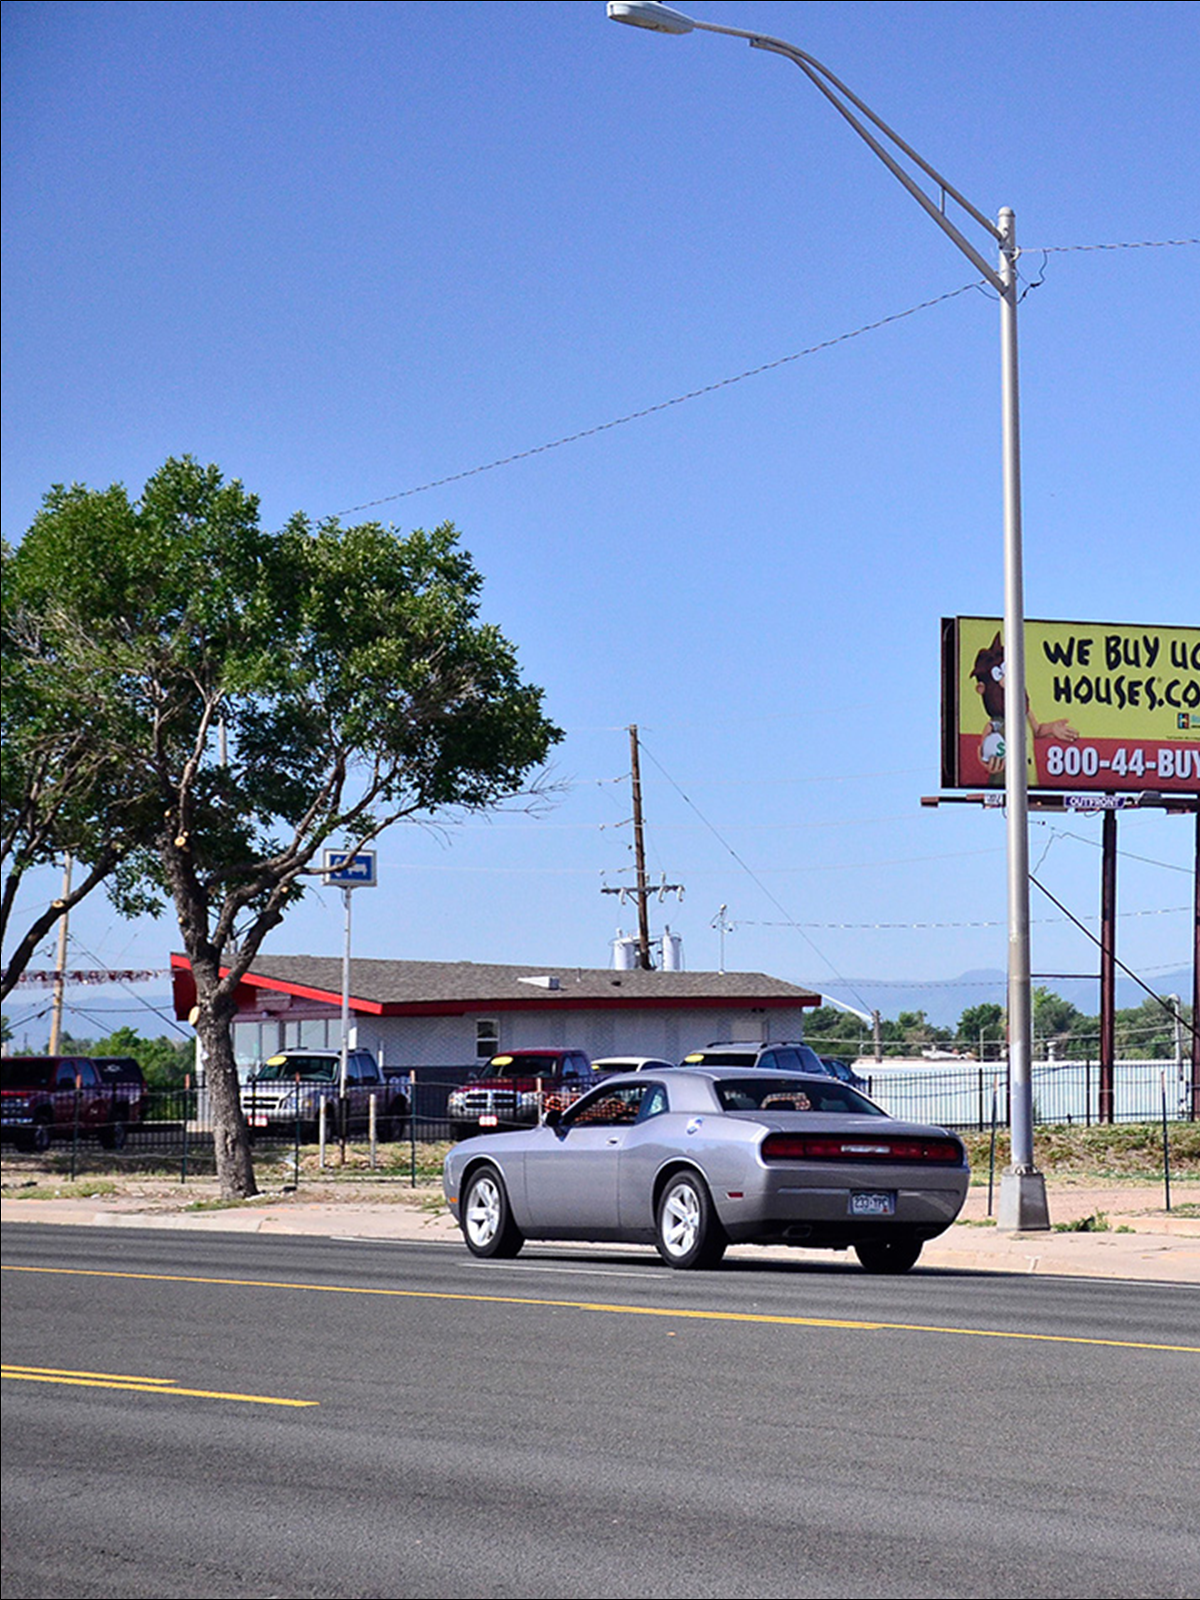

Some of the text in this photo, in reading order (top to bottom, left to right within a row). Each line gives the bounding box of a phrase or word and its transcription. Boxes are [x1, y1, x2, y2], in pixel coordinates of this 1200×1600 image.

[1043, 636, 1094, 668] WE
[1104, 635, 1160, 671] BUY
[1069, 796, 1119, 807] OUTFRONT
